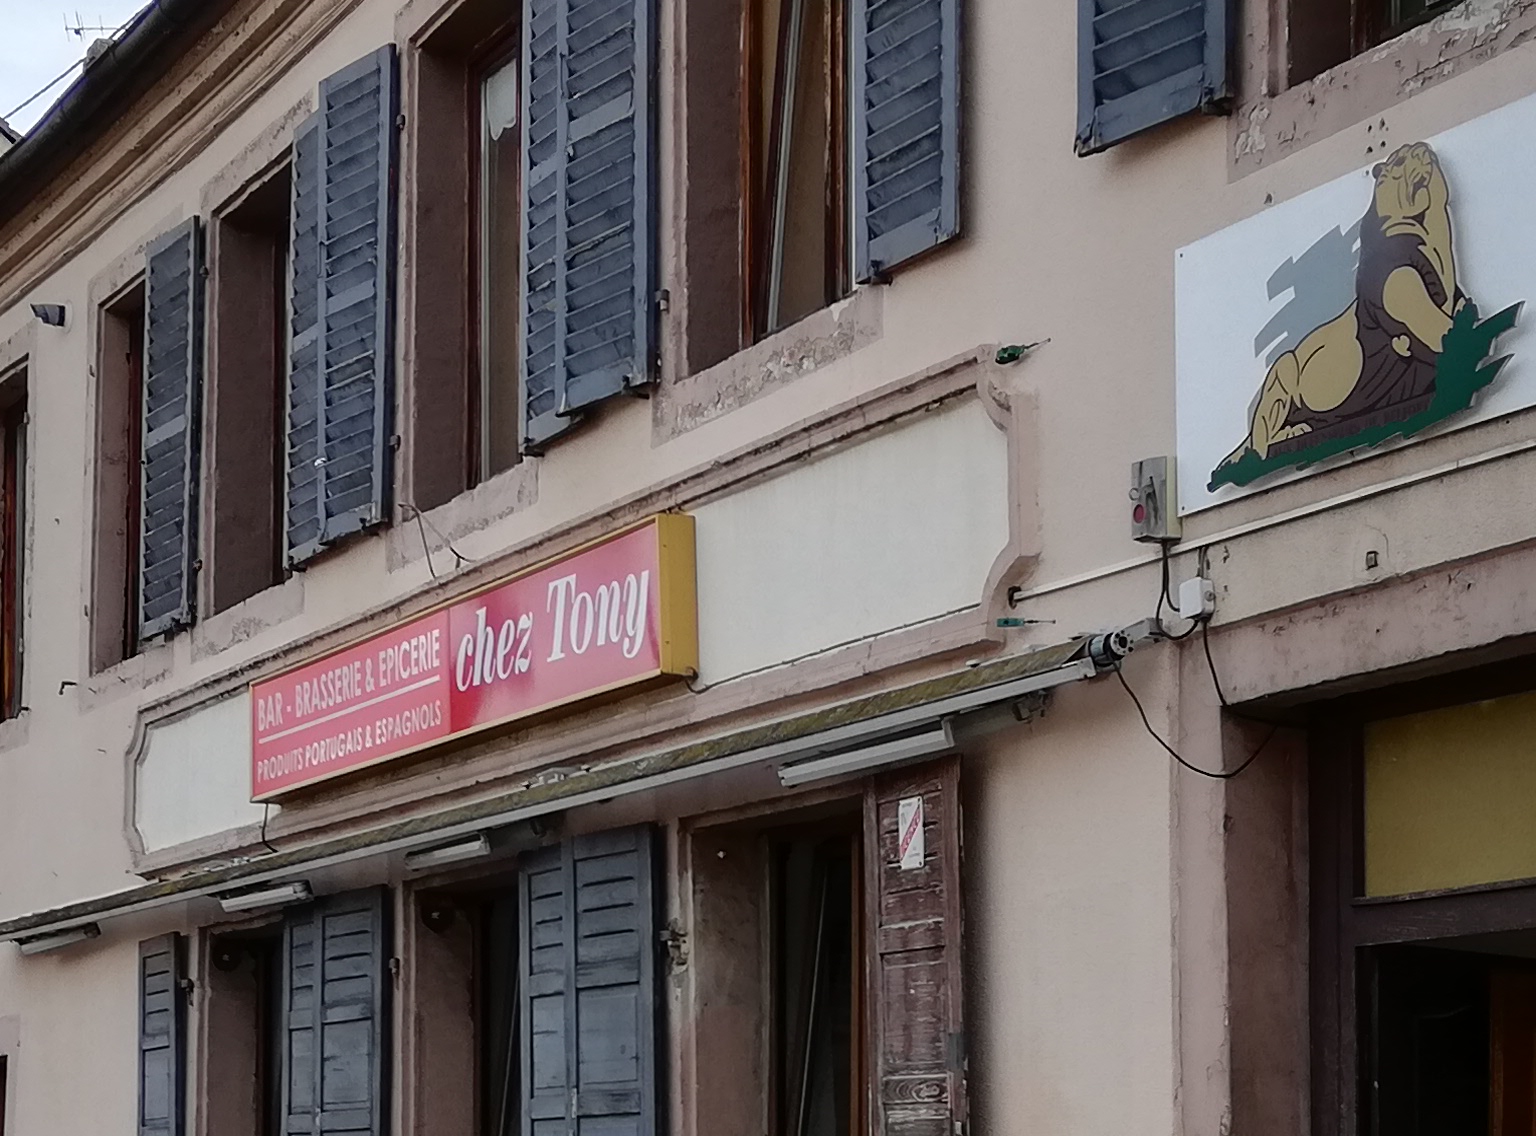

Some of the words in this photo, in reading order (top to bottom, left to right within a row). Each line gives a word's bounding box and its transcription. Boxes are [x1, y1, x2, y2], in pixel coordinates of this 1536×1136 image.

[257, 691, 283, 732] BAR
[295, 660, 362, 718] BRASSERIE
[365, 657, 375, 693] &
[378, 628, 440, 687] EPICERIE
[455, 606, 533, 692] chez
[546, 569, 650, 663] Tony
[257, 746, 304, 783] PRODUITS
[305, 726, 363, 767] PORTUGAIS
[365, 724, 373, 748] &
[375, 700, 442, 745] ESPAGNOLS
